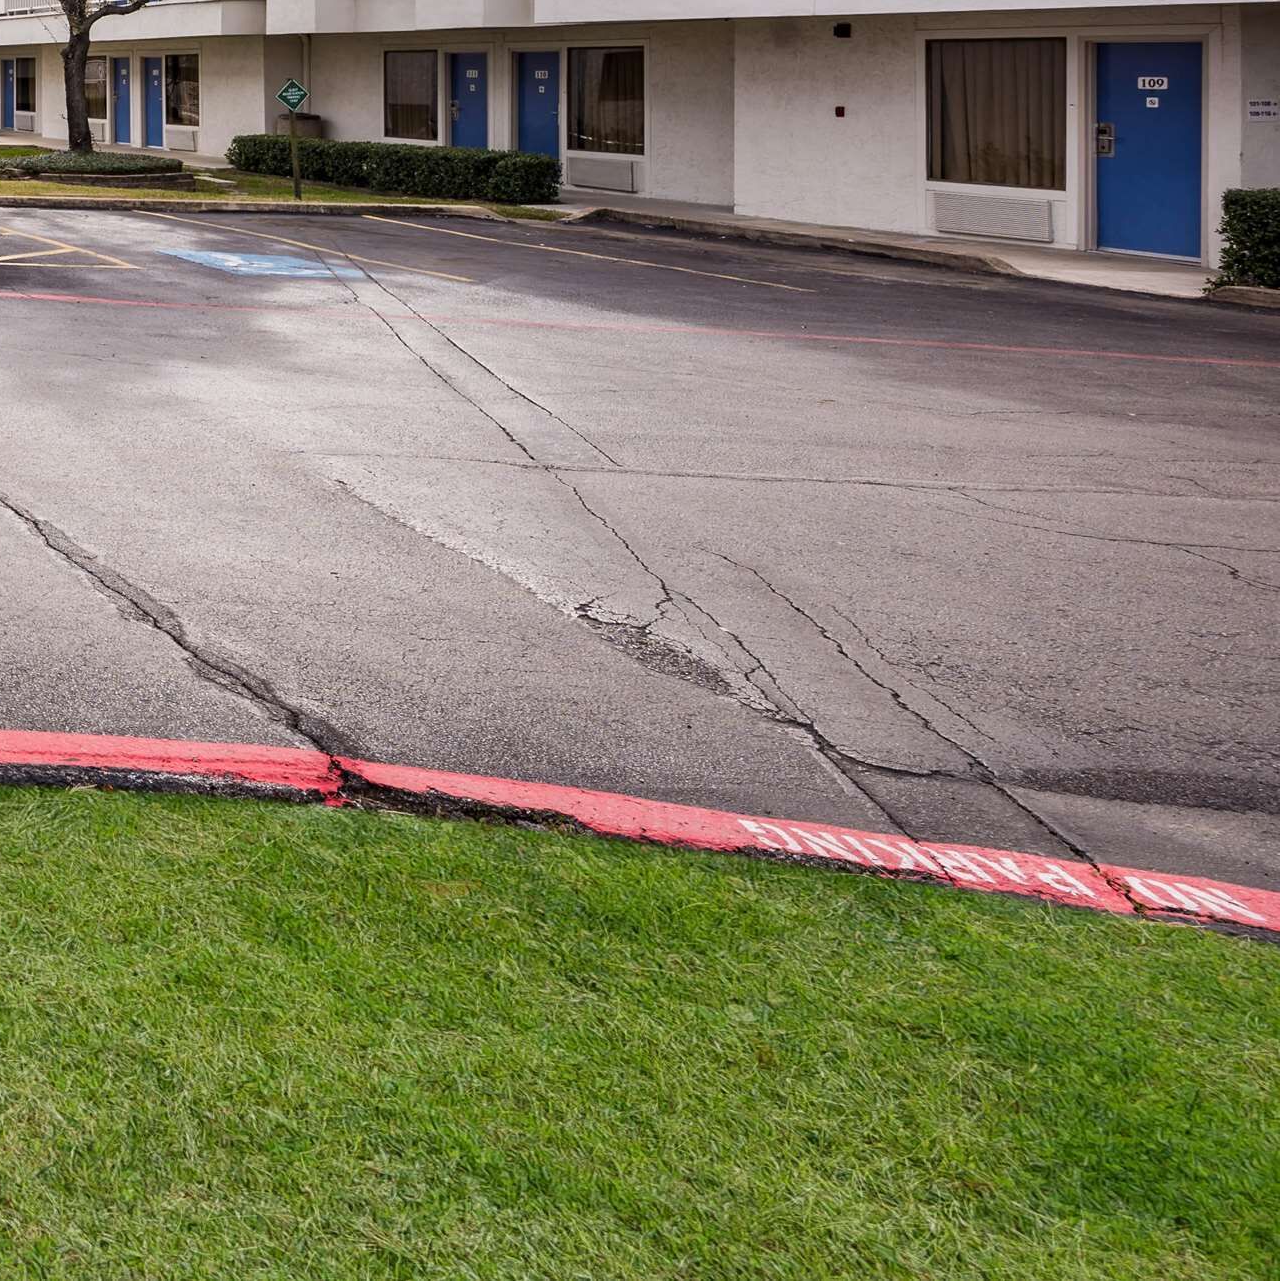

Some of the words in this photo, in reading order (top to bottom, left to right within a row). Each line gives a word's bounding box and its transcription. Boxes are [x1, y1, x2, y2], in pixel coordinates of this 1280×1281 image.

[1141, 78, 1165, 88] 109
[737, 818, 1097, 899] PARKING
[1124, 875, 1266, 921] NO
